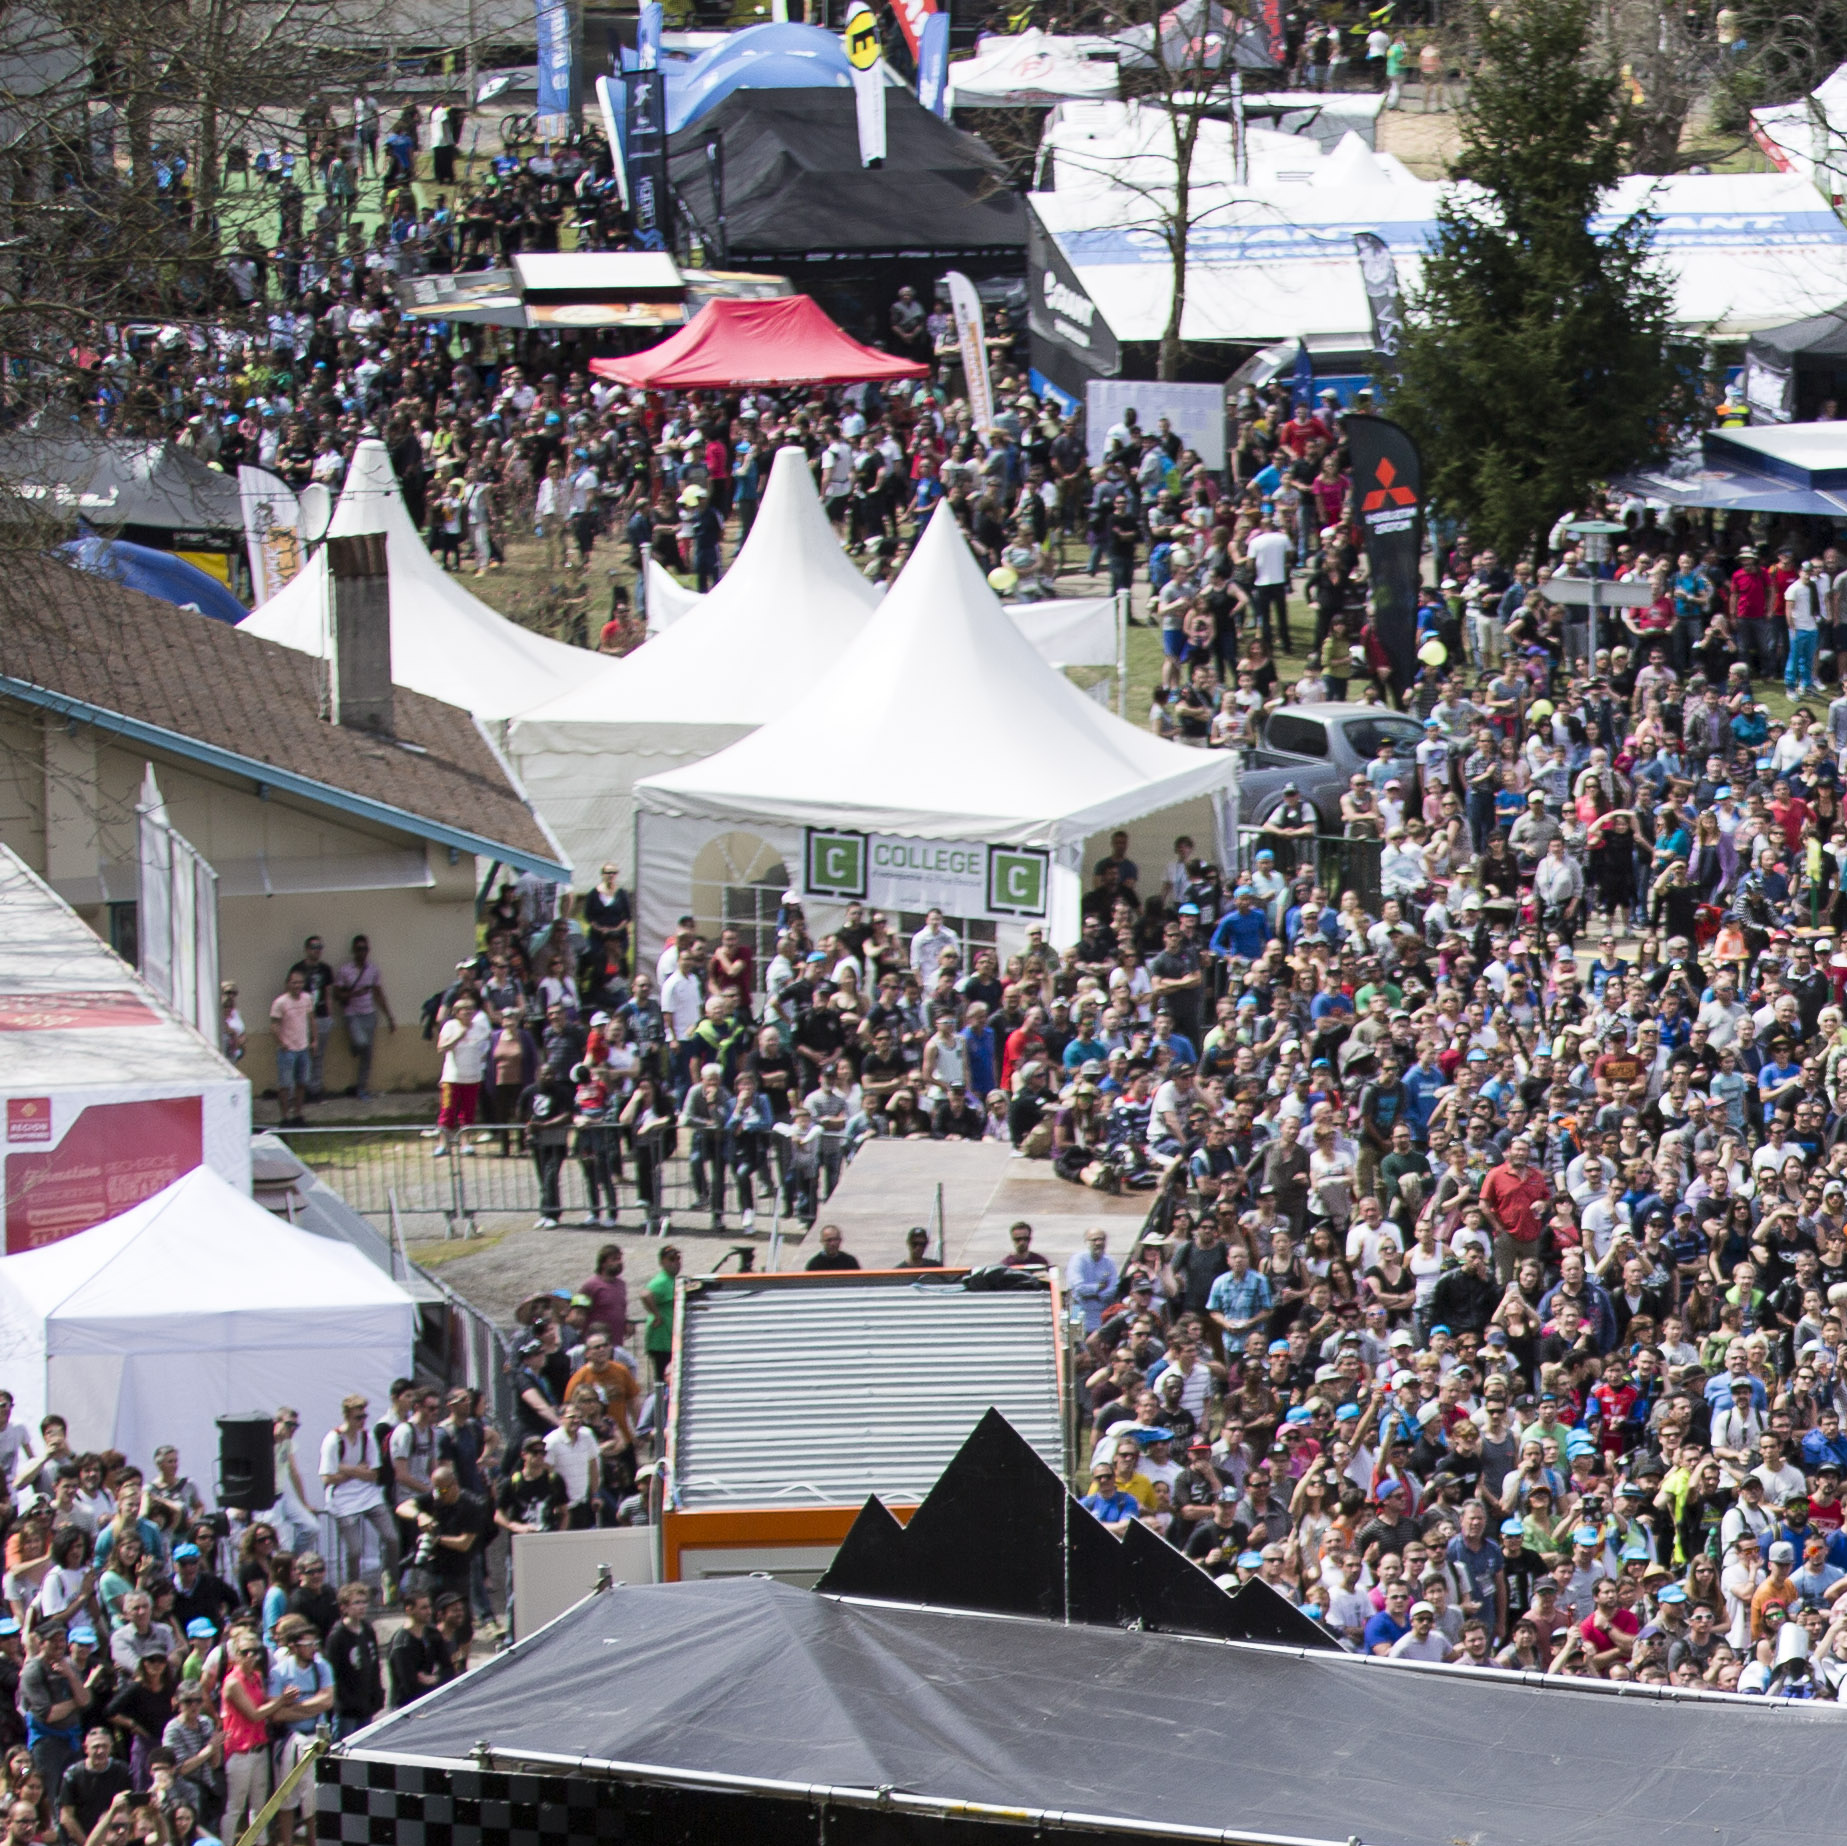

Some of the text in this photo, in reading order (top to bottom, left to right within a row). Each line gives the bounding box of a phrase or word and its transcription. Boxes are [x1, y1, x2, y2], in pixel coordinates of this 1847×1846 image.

[826, 846, 848, 877] C
[873, 843, 981, 875] COLLEGE
[1008, 865, 1029, 898] C
